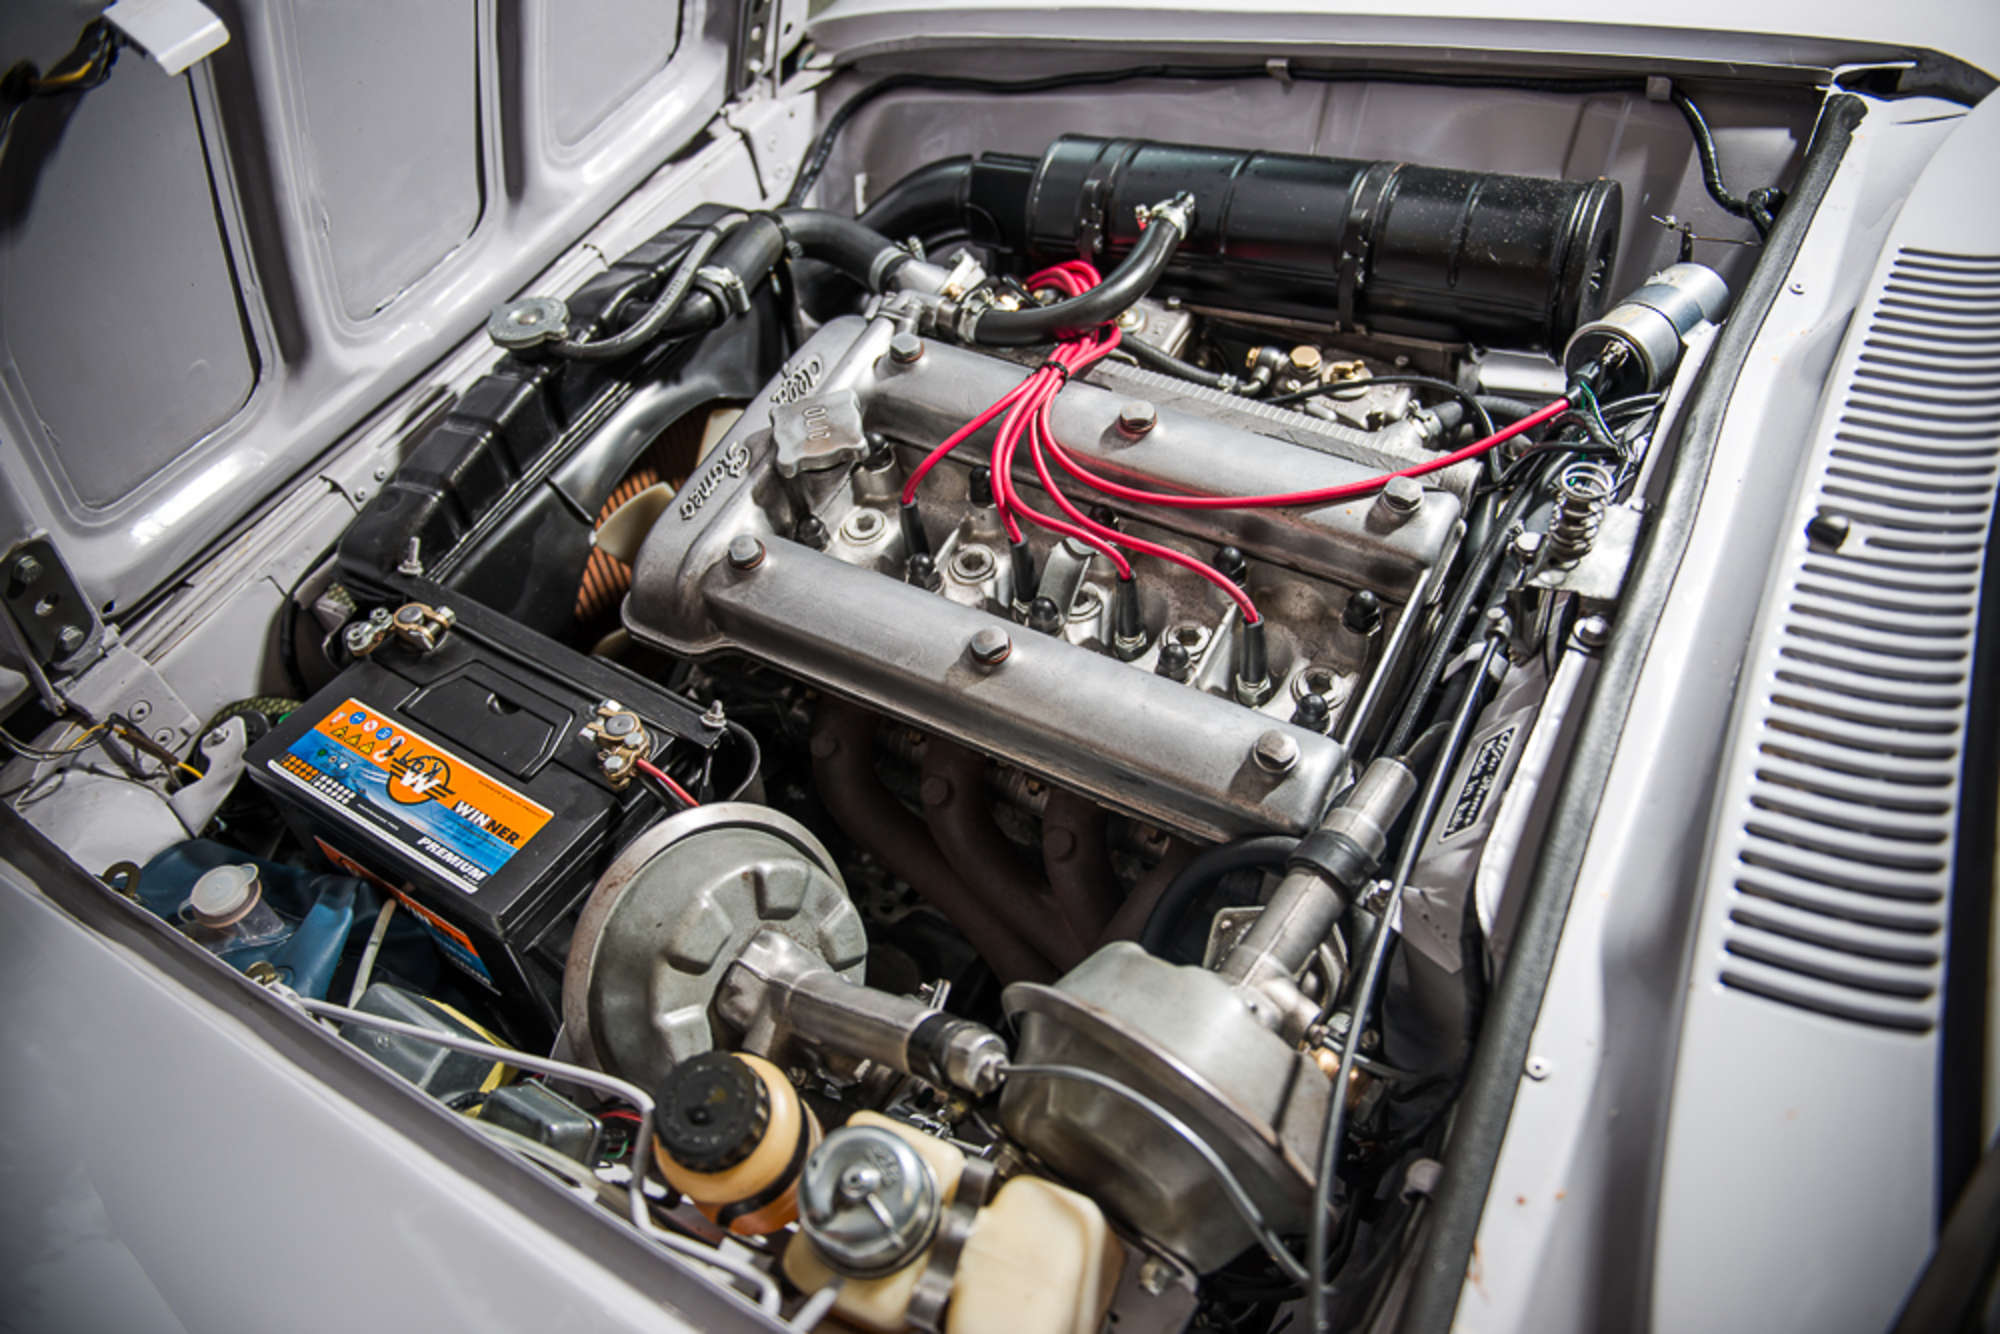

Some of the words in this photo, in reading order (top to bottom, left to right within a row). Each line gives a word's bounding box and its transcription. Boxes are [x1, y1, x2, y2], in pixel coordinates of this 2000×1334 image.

[770, 356, 822, 404] Alfa
[679, 441, 750, 520] Romeo
[452, 800, 521, 845] WINNER
[417, 835, 488, 881] PREMIUM
